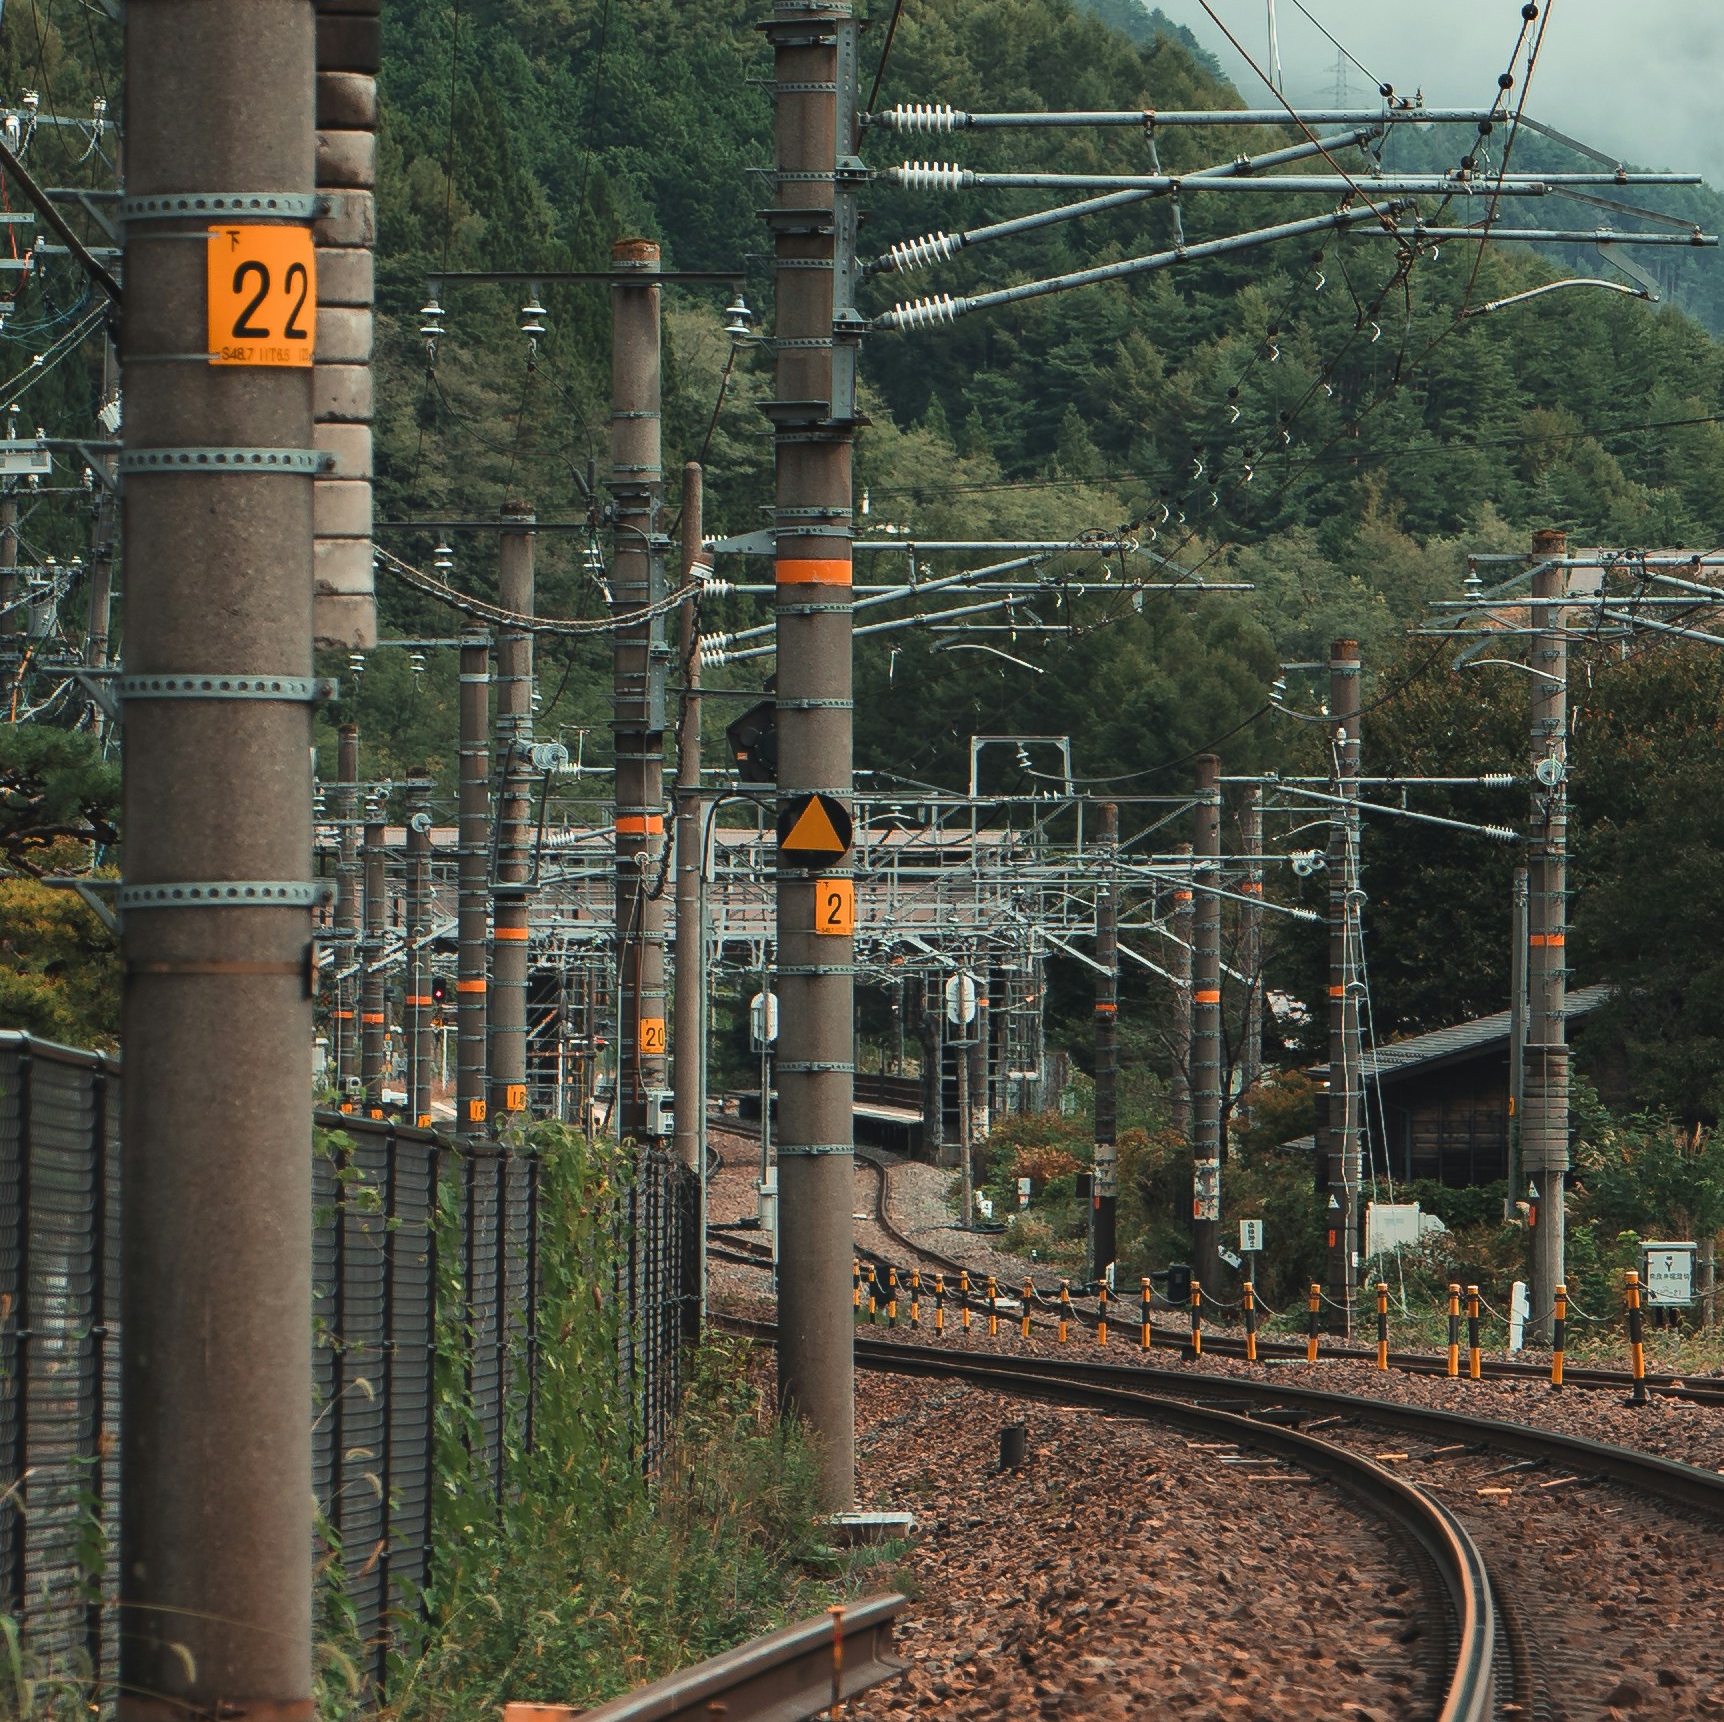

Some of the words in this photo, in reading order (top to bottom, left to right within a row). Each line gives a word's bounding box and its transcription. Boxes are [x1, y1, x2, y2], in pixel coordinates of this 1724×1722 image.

[226, 230, 240, 253] 下
[231, 260, 308, 340] 22
[827, 892, 852, 925] 21
[645, 1026, 664, 1047] 20
